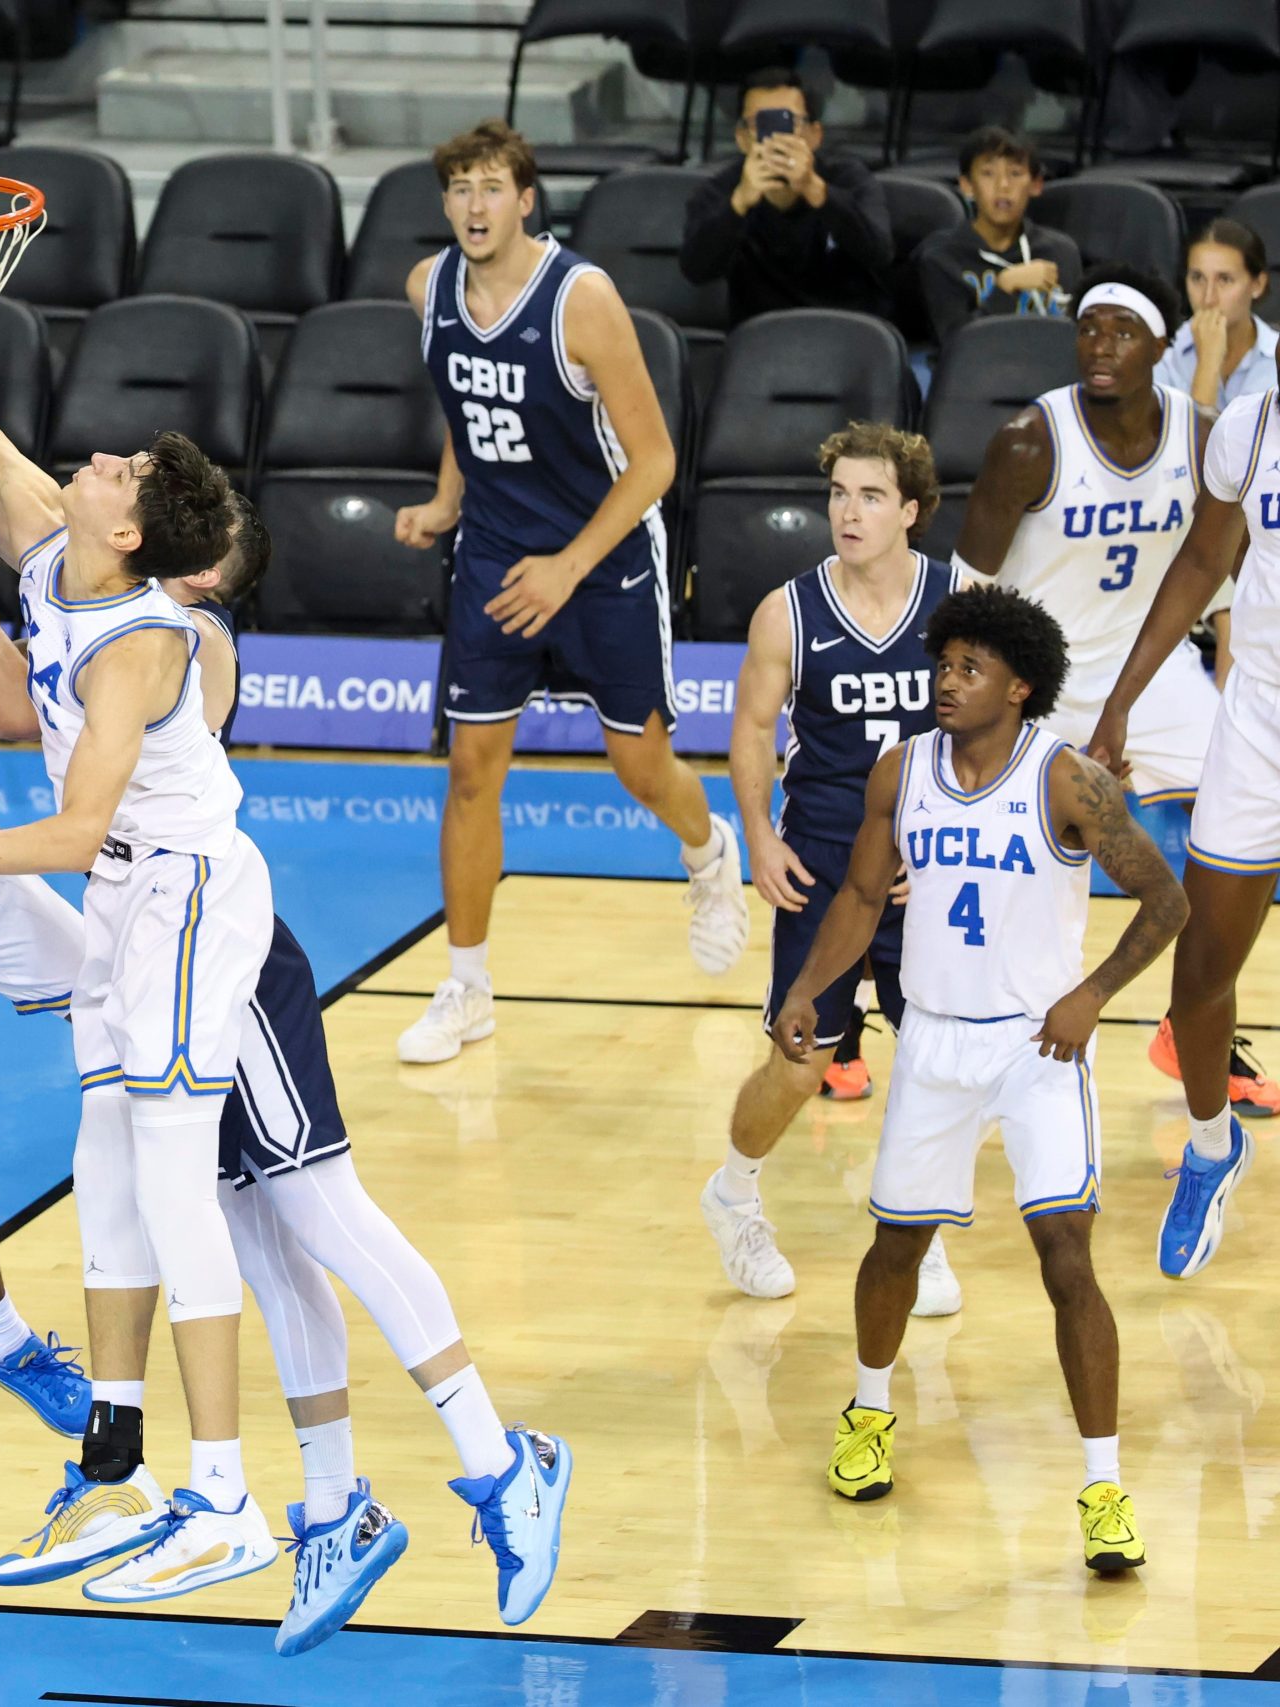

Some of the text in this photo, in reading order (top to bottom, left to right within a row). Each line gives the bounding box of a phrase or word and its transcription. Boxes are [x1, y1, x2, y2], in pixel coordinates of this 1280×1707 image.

[448, 352, 526, 403] CBU
[461, 400, 533, 463] 22
[1063, 499, 1183, 538] UCLA
[1099, 544, 1138, 591] 3
[239, 672, 432, 713] SEIA.COM
[831, 669, 931, 713] CBU
[865, 719, 900, 762] 7
[907, 827, 1035, 875] UCLA
[948, 882, 985, 946] 4
